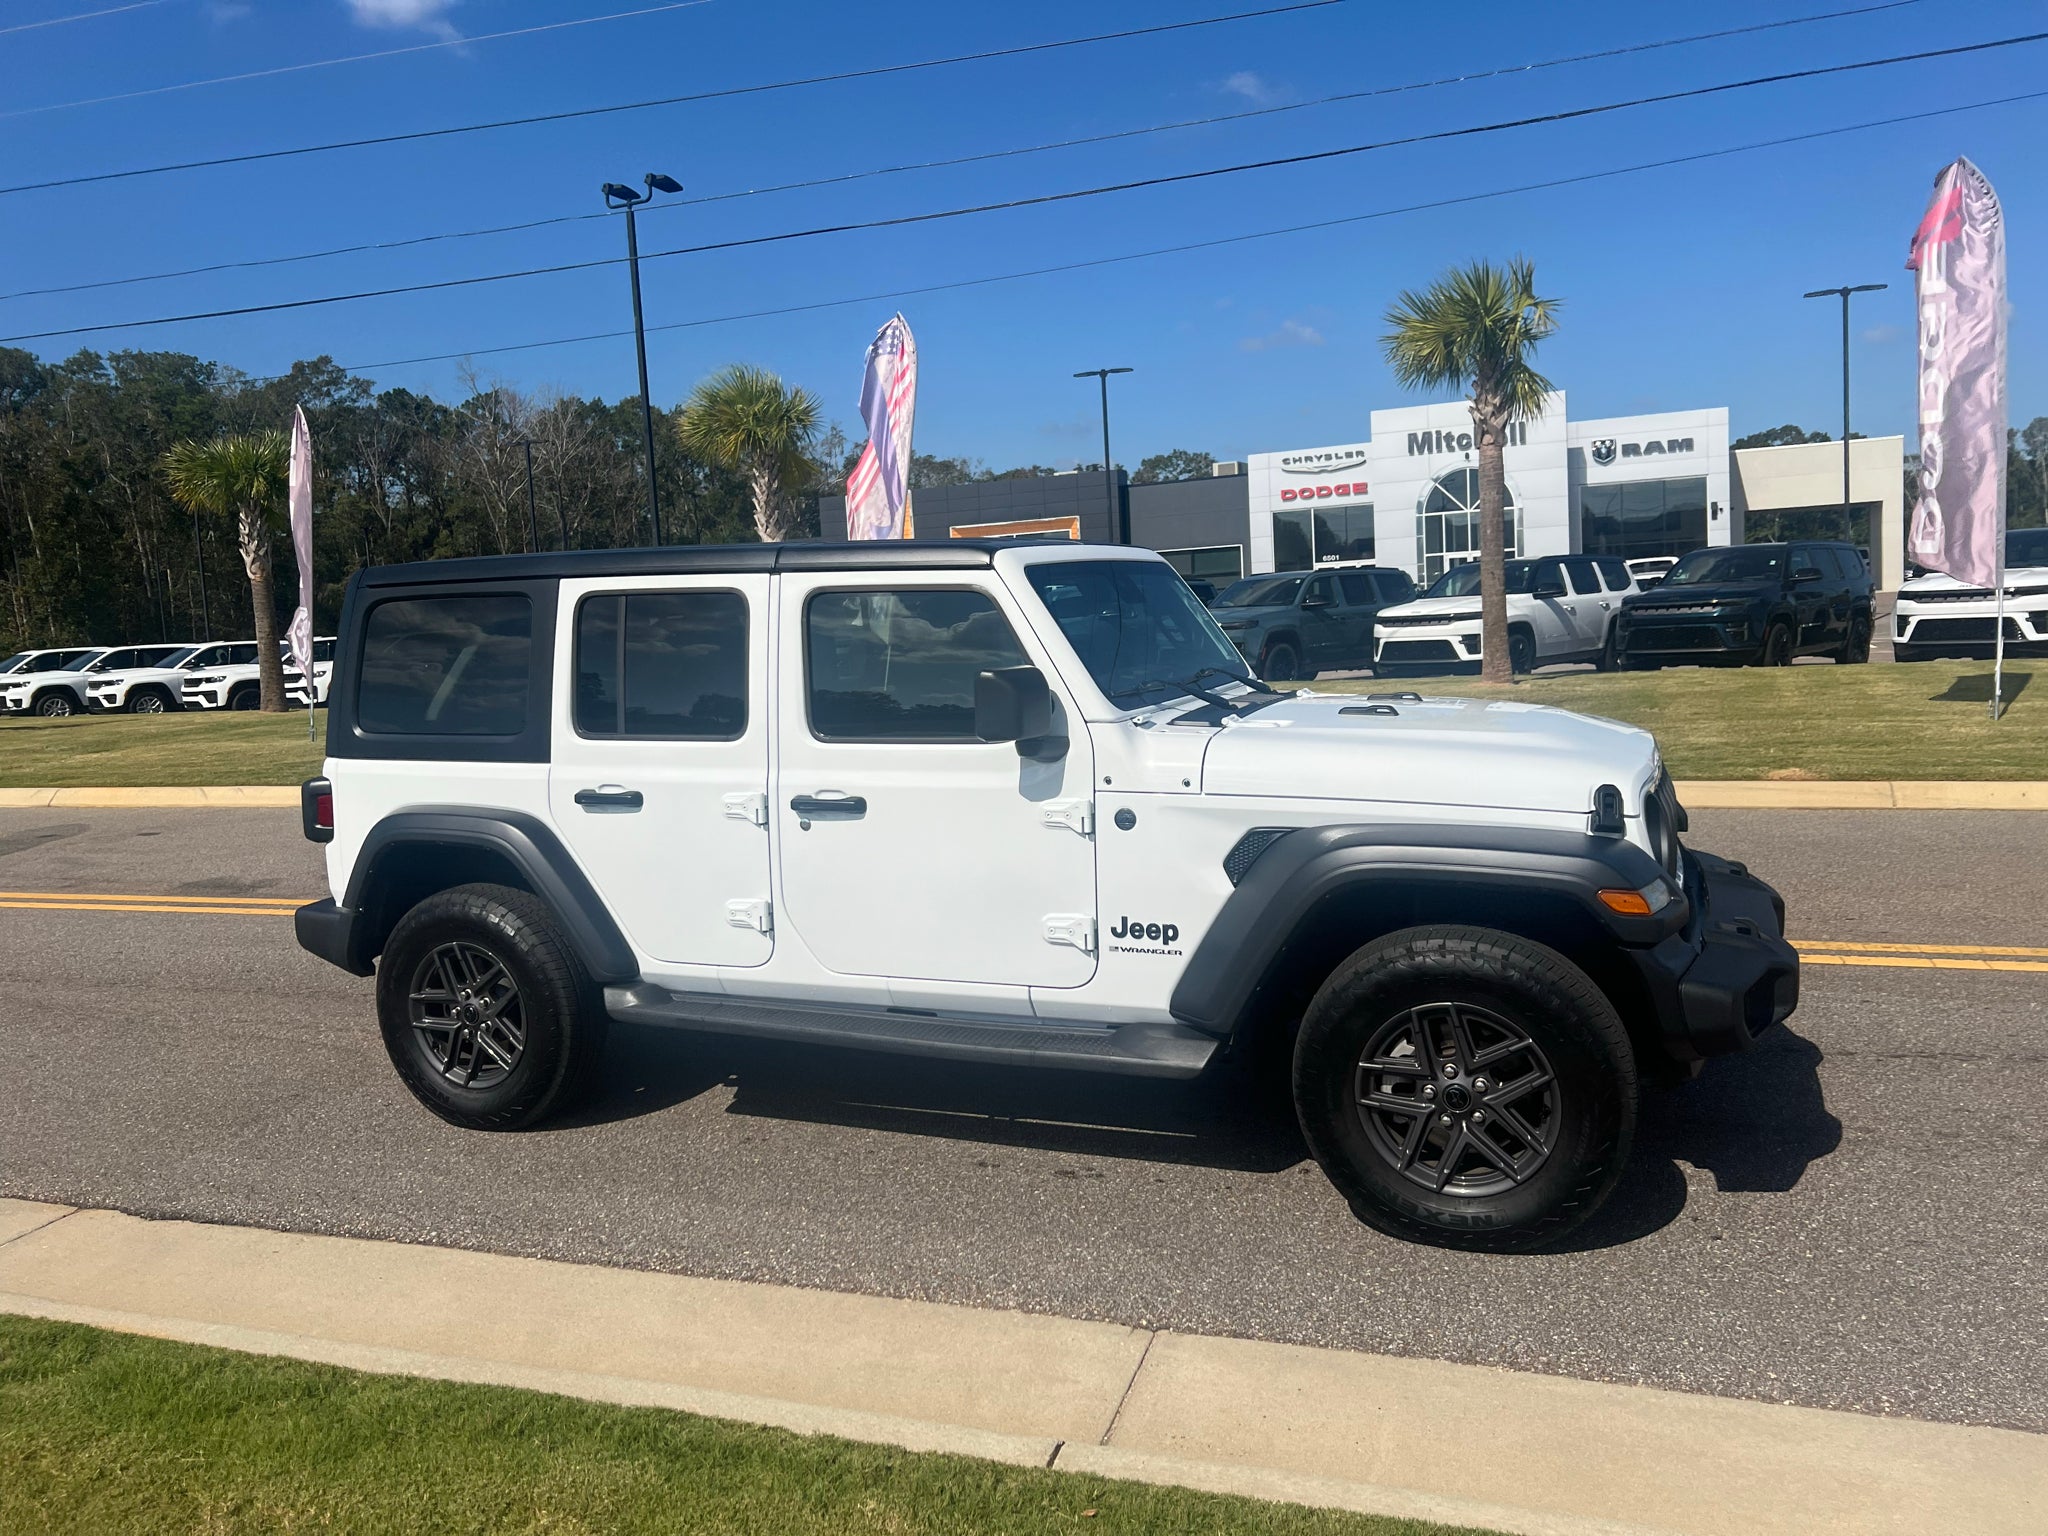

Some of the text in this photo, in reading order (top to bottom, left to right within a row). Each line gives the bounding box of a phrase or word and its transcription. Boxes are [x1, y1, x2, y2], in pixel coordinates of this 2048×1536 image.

[1408, 421, 1527, 456] Mitcll
[1621, 438, 1694, 458] RAM
[1282, 450, 1365, 465] CHRYSLER
[1281, 482, 1368, 502] DODGE
[1110, 916, 1179, 945] Jeep
[1120, 946, 1183, 956] WRANGLER
